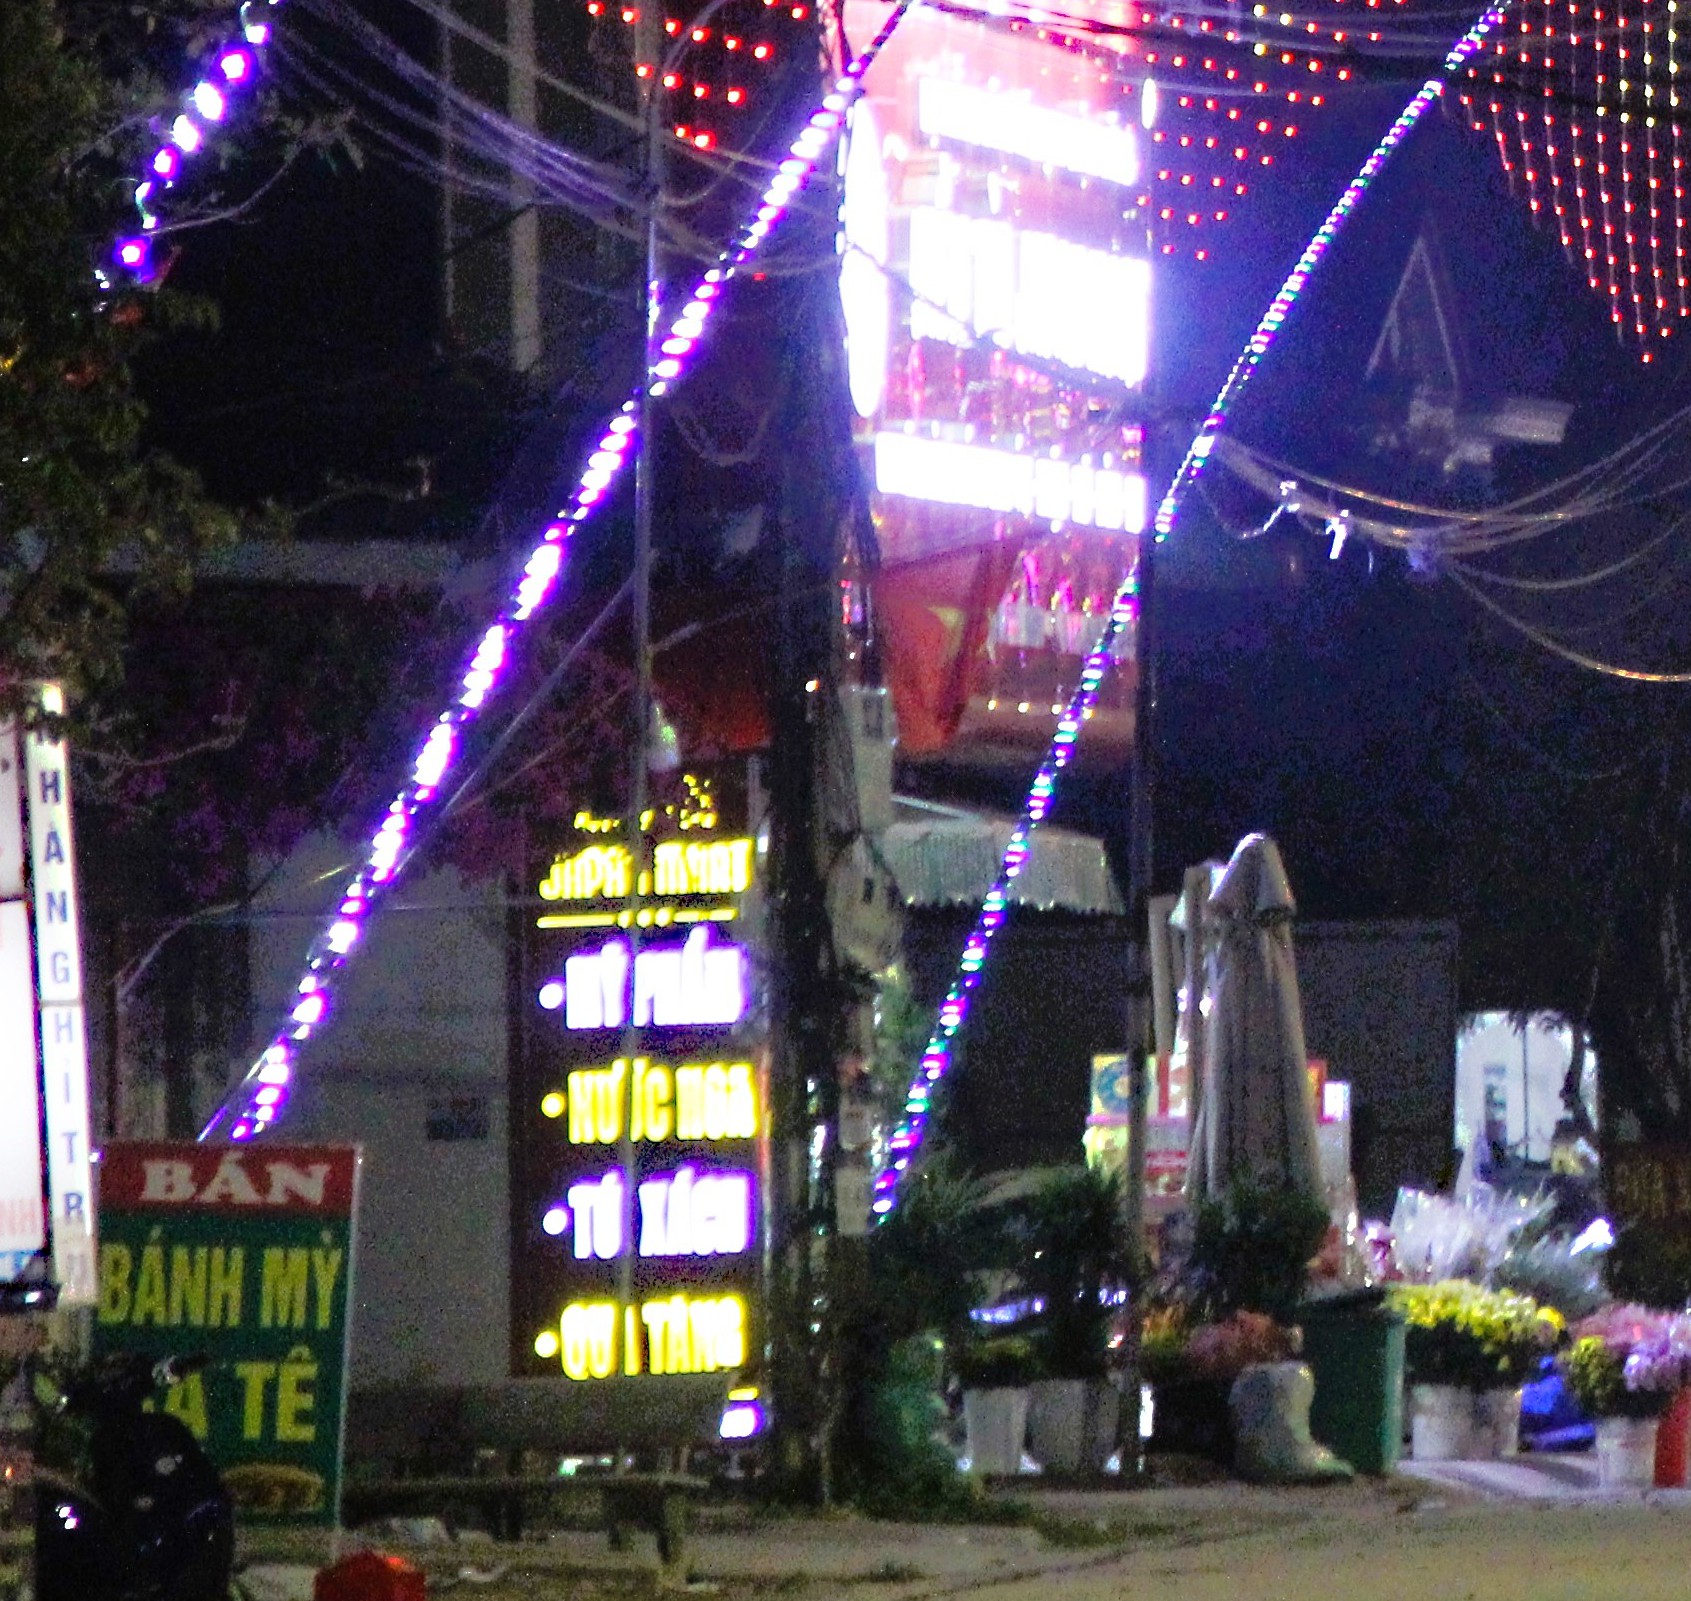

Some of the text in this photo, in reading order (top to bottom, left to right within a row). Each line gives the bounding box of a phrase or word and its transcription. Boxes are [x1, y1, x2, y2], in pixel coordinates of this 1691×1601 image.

[140, 1151, 330, 1204] BÁN
[98, 1225, 245, 1328] BÁNH
[235, 1344, 319, 1442] TÊ
